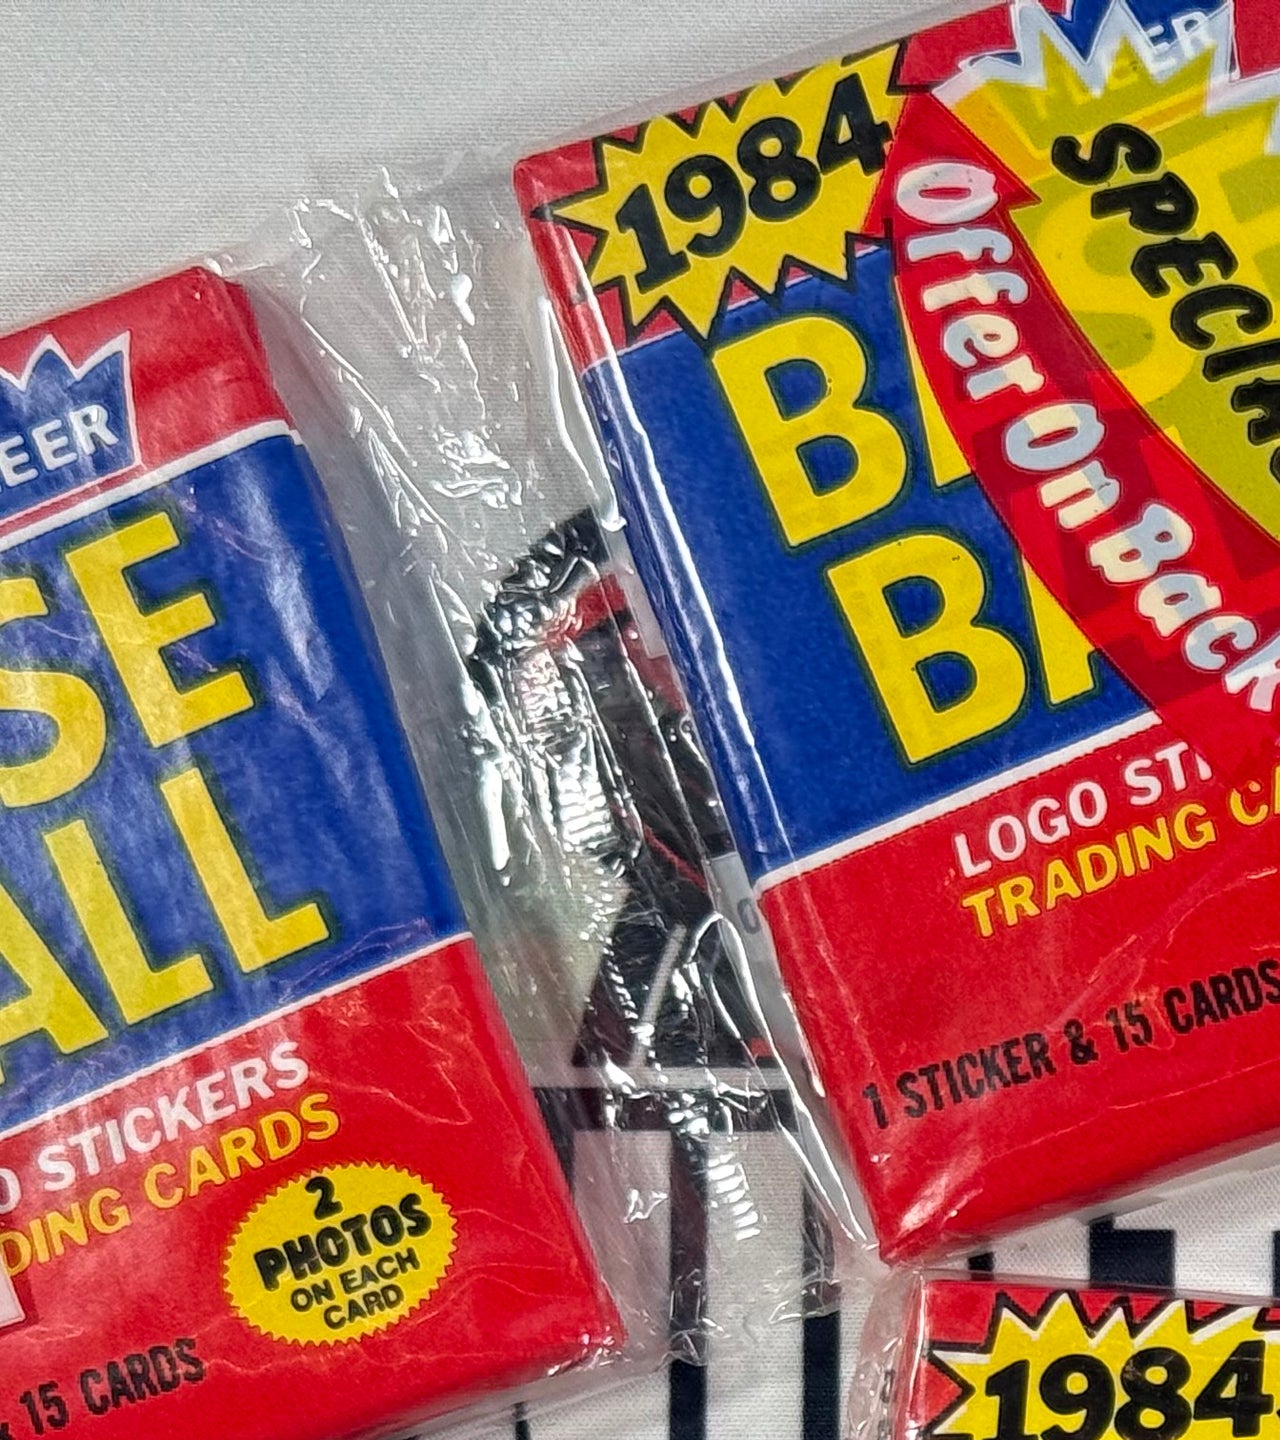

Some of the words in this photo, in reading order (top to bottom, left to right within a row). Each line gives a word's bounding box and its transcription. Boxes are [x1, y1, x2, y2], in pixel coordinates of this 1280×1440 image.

[616, 74, 891, 293] 1984
[896, 162, 1044, 401] Offer
[1003, 402, 1123, 529] On
[0, 405, 119, 488] EER
[0, 512, 254, 808] SE
[953, 780, 1108, 879] LOGO
[962, 803, 1215, 938] TRADING
[0, 767, 330, 1083] ALL
[37, 1041, 309, 1191] STICKERS
[863, 1082, 890, 1130] 1
[896, 1031, 1055, 1119] STICKER
[1071, 1020, 1099, 1066] &
[1106, 1001, 1153, 1054] 15
[0, 1187, 130, 1276] DING
[144, 1093, 339, 1209] CARDS
[254, 1192, 432, 1291] PHOTOS
[306, 1176, 343, 1220] 2
[290, 1272, 335, 1312] ON
[340, 1247, 420, 1296] EACH
[323, 1284, 403, 1330] CARD
[19, 1381, 70, 1435] 15
[80, 1339, 205, 1416] CARDS
